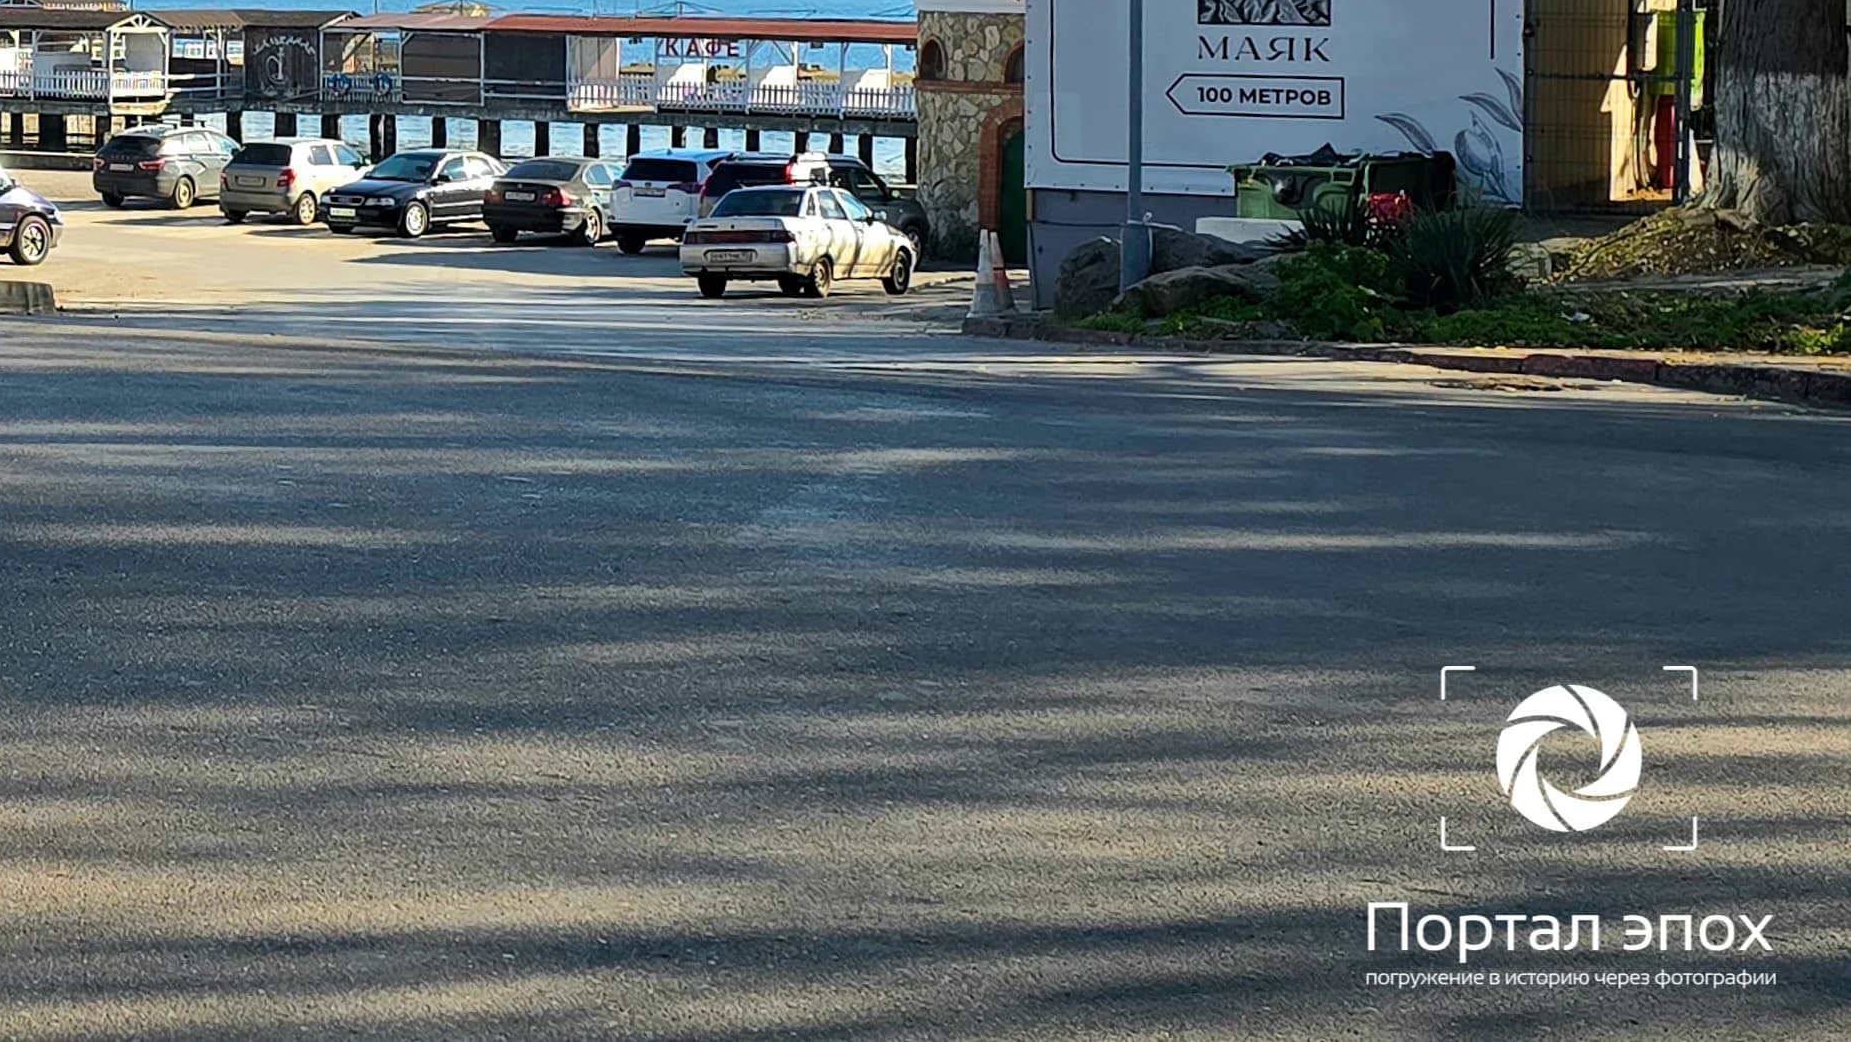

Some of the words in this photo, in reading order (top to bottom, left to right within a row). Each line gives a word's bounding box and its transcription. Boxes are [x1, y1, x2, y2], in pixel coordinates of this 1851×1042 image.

[665, 37, 740, 57] КАФЕ
[1198, 36, 1330, 62] МАЯК
[1197, 87, 1232, 103] 100
[1240, 88, 1331, 105] МЕТРОВ
